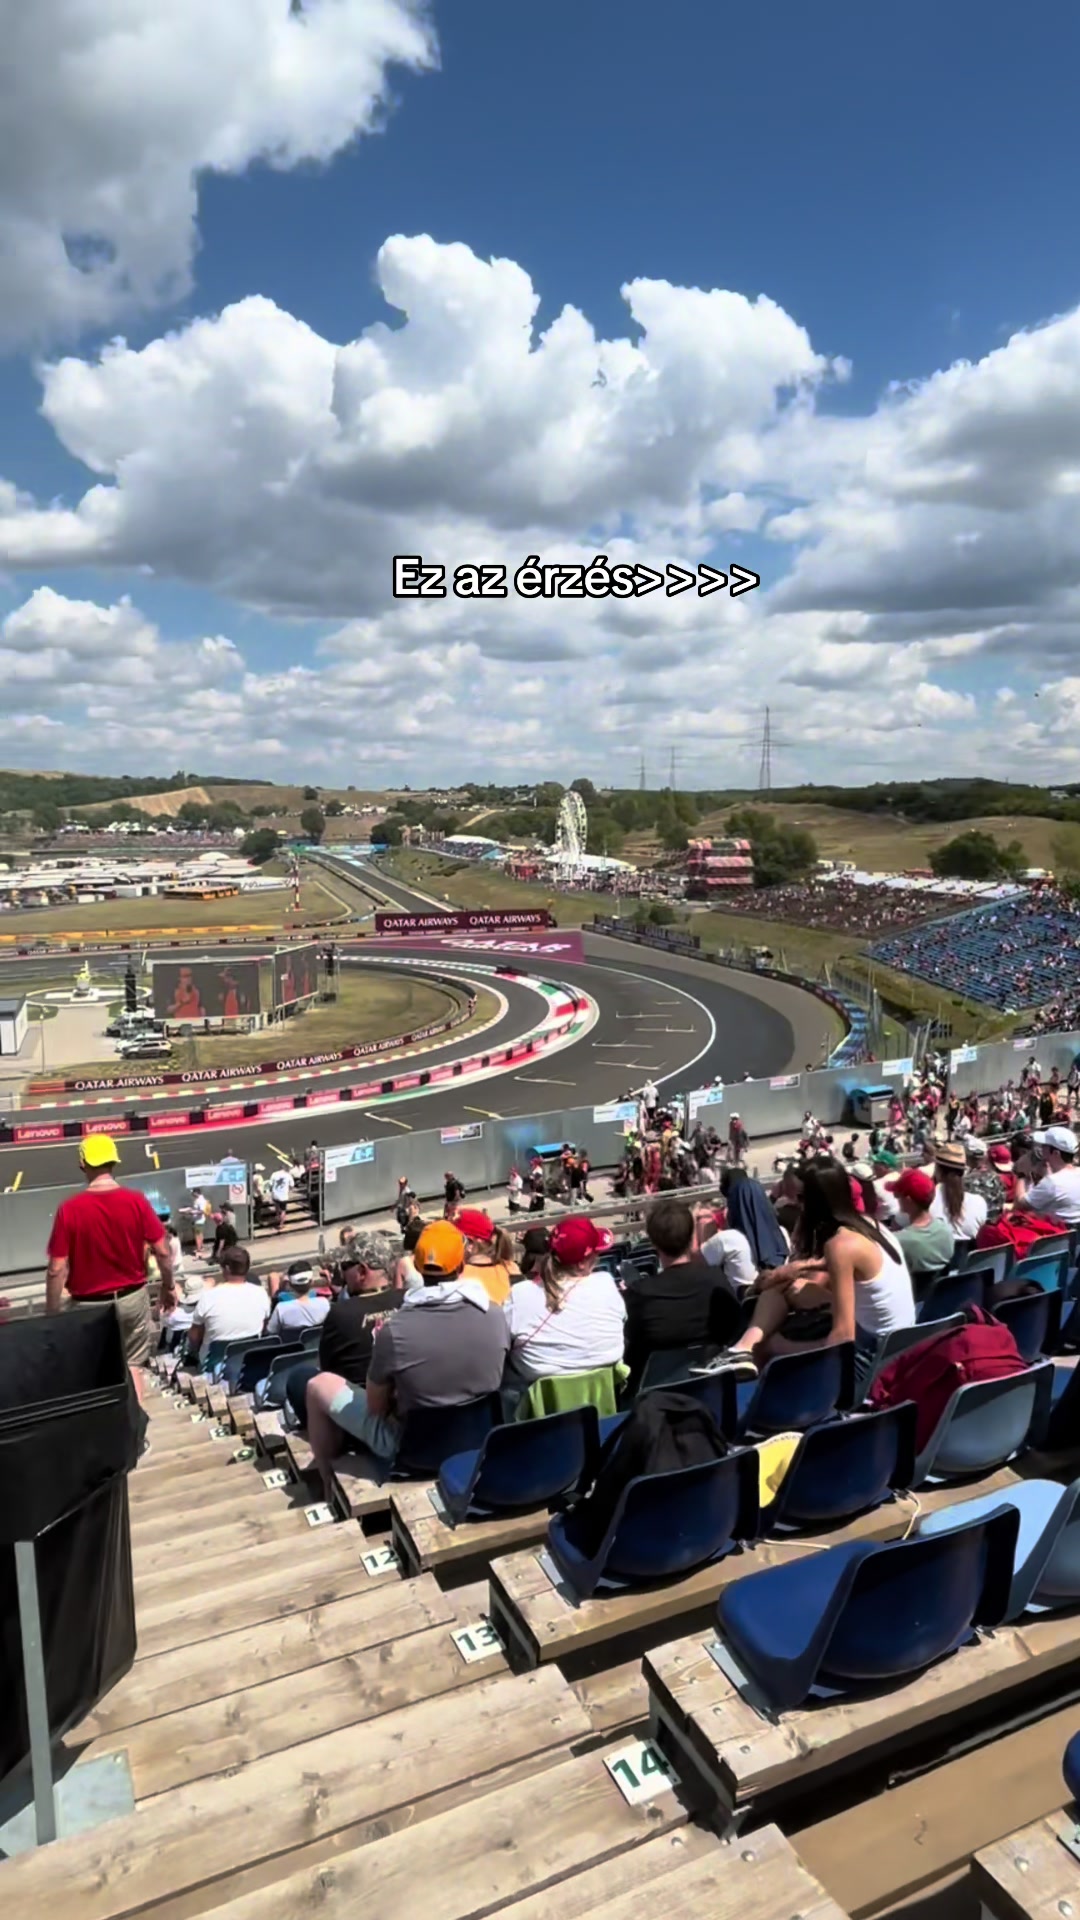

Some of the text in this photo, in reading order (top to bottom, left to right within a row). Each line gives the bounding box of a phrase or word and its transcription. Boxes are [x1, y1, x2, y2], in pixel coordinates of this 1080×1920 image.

[383, 917, 459, 928] QATAR AIRWAYS
[469, 914, 541, 926] QATAR AIRWAYS
[276, 1052, 344, 1071] QATAR AIRWAYS
[181, 1065, 262, 1083] QATAR AIRWAYS
[75, 1076, 164, 1091] QATAR AIRWAYS
[85, 1121, 127, 1133] Lenovo
[150, 1114, 187, 1127] Lenovo
[17, 1128, 60, 1140] Lenovo
[266, 1472, 289, 1485] 10
[306, 1503, 338, 1522] 11
[363, 1548, 399, 1569] 12
[456, 1625, 499, 1652] 13
[610, 1746, 669, 1788] 14
